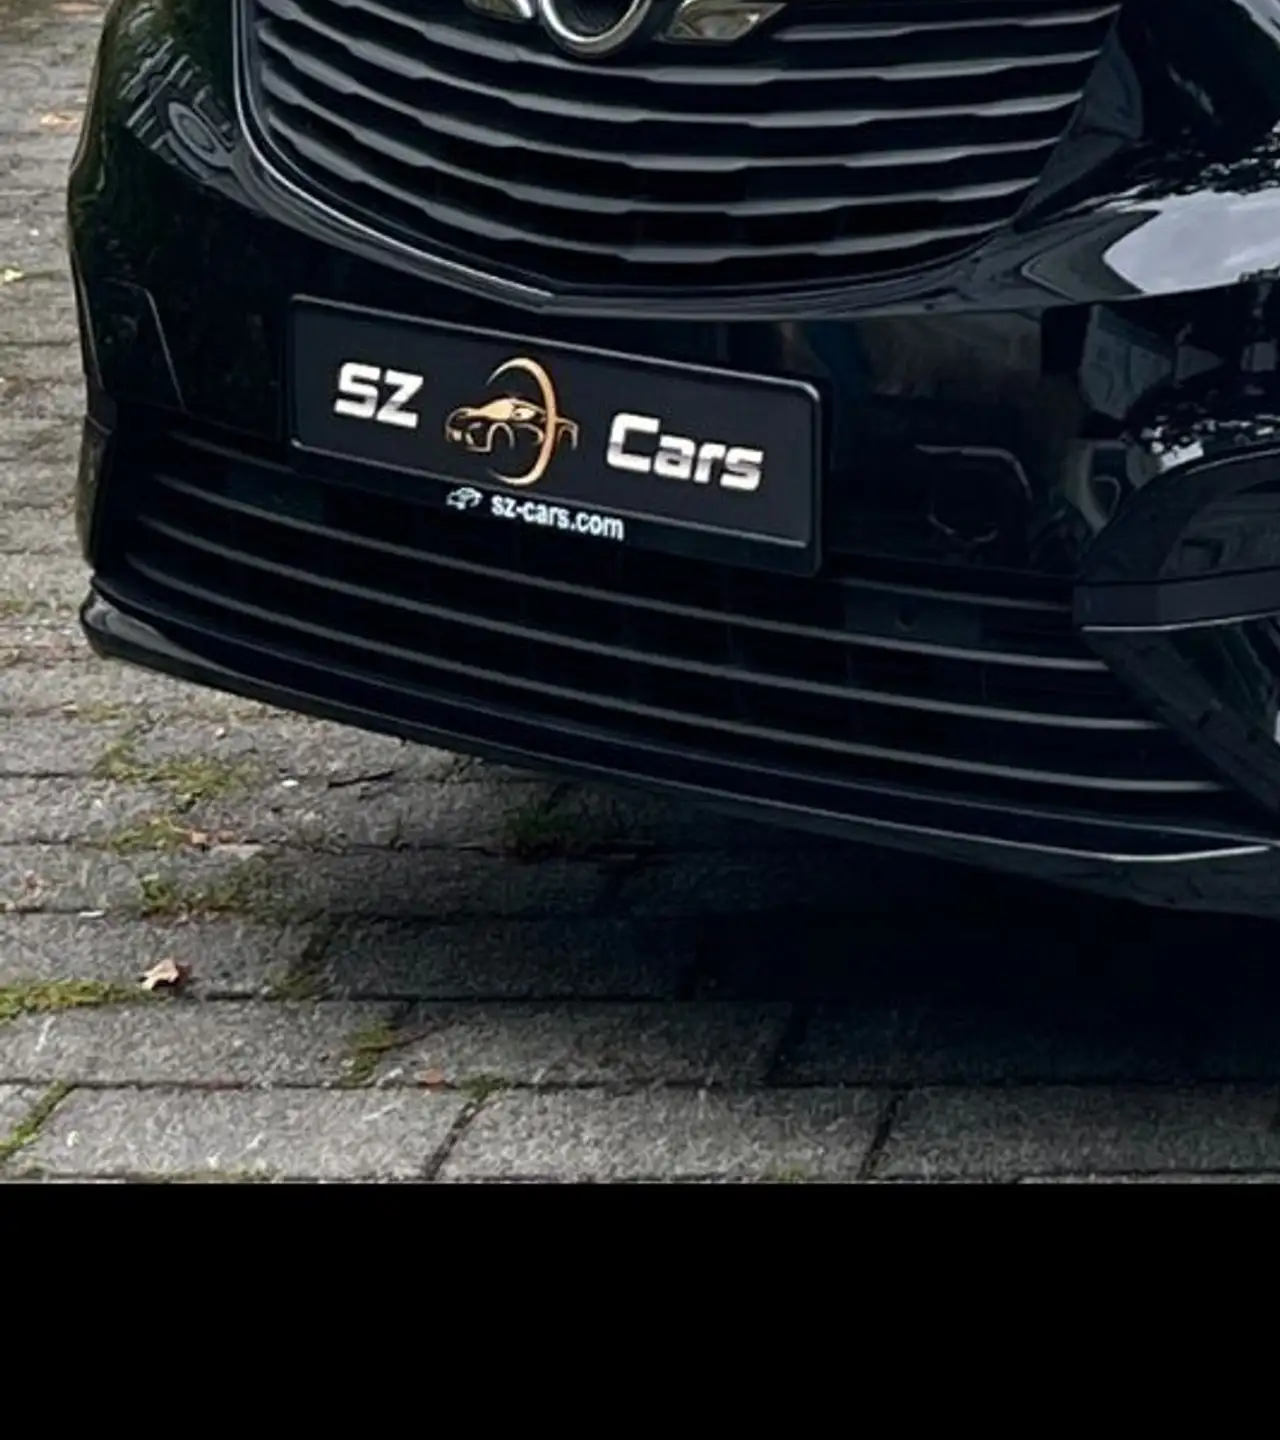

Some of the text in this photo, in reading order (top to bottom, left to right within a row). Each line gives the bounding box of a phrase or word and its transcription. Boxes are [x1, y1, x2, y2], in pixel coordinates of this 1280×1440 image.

[333, 361, 764, 491] SZ Cars
[490, 494, 625, 541] sz-cars.com
